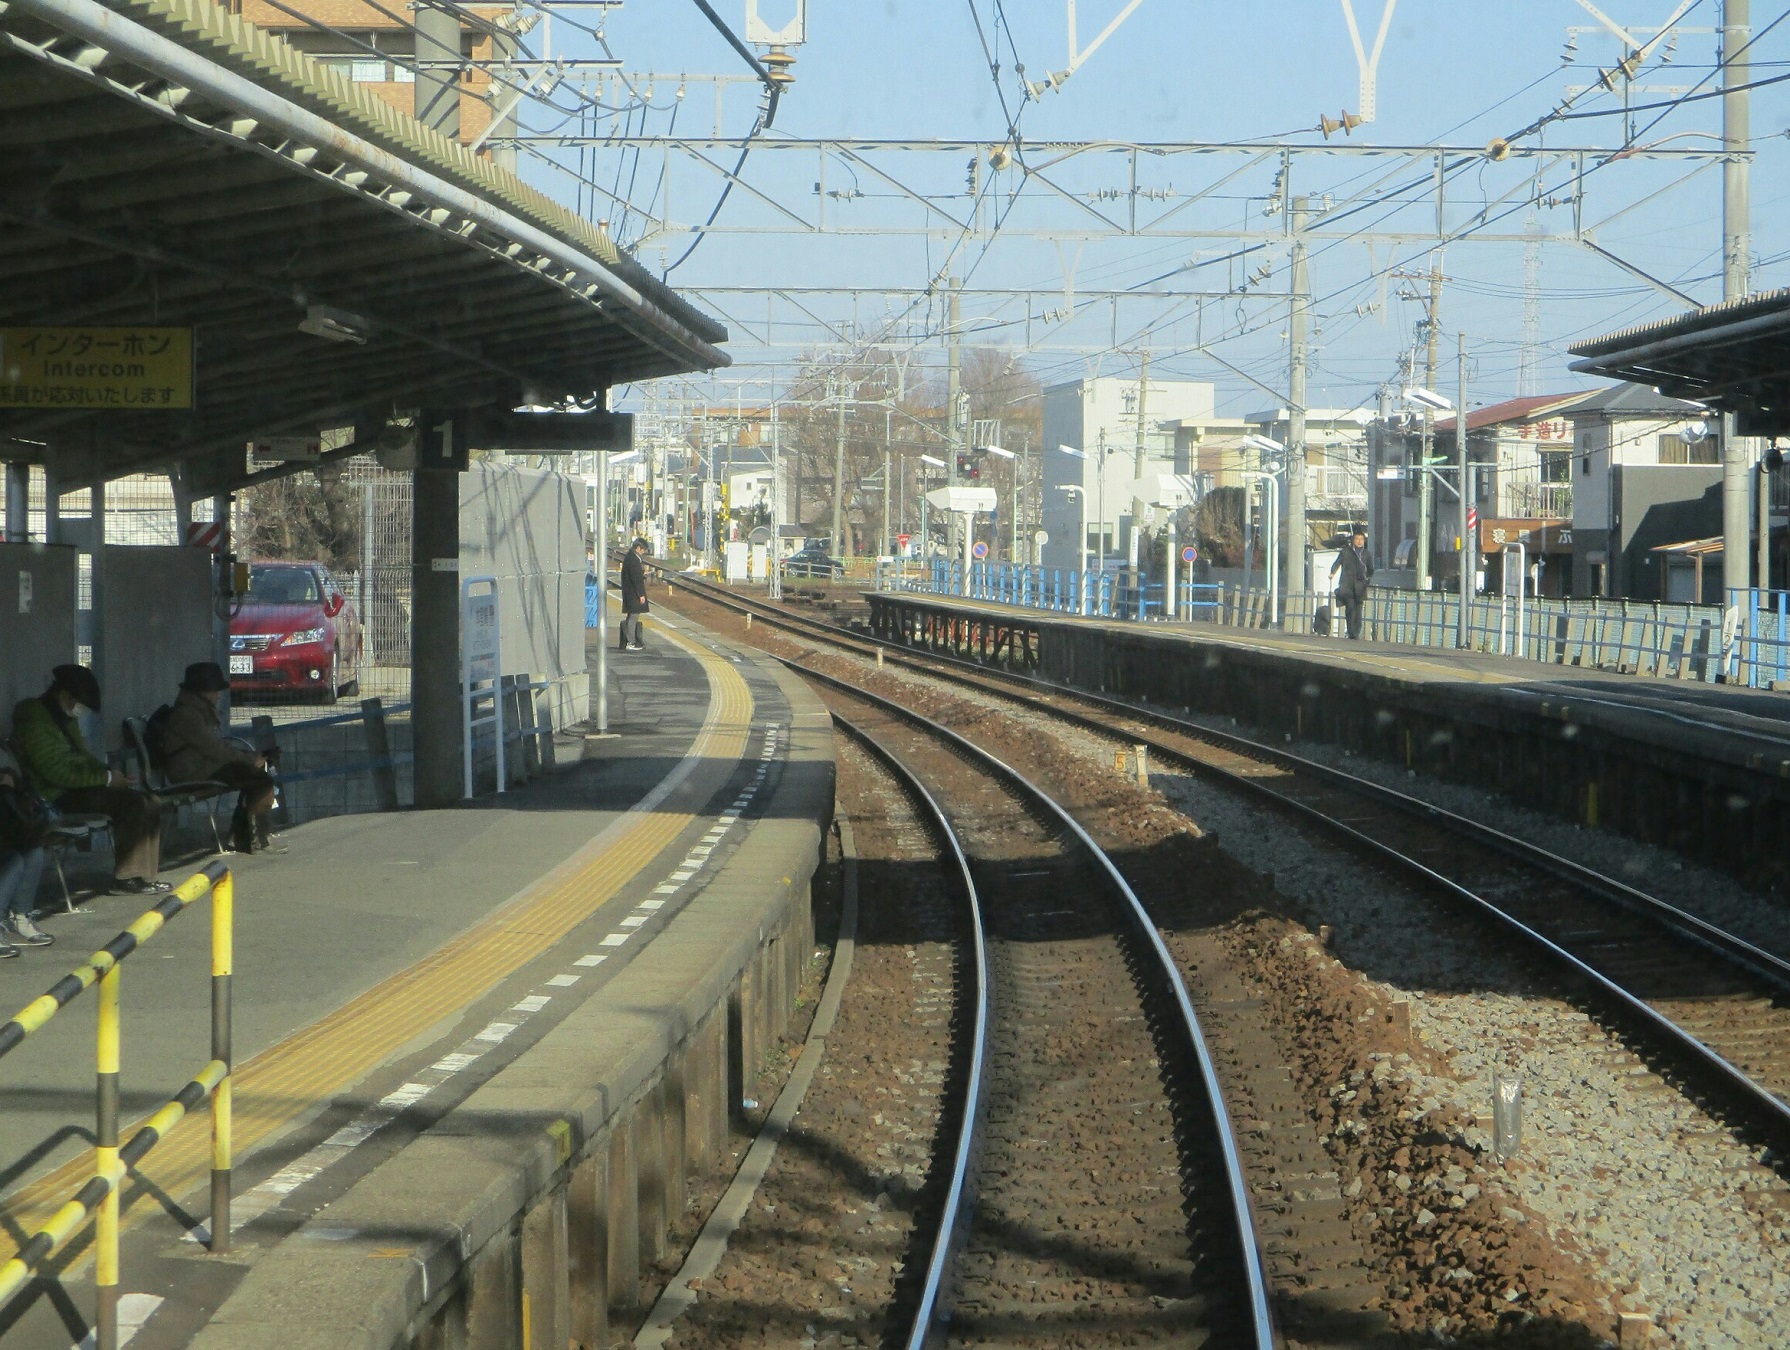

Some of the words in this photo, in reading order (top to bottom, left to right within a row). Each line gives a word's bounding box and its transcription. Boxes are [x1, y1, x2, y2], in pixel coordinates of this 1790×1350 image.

[21, 333, 171, 356] インターホン
[44, 360, 145, 377] Intercom
[432, 419, 453, 458] 1
[1518, 421, 1573, 440] 手造り
[1116, 756, 1125, 771] 5
